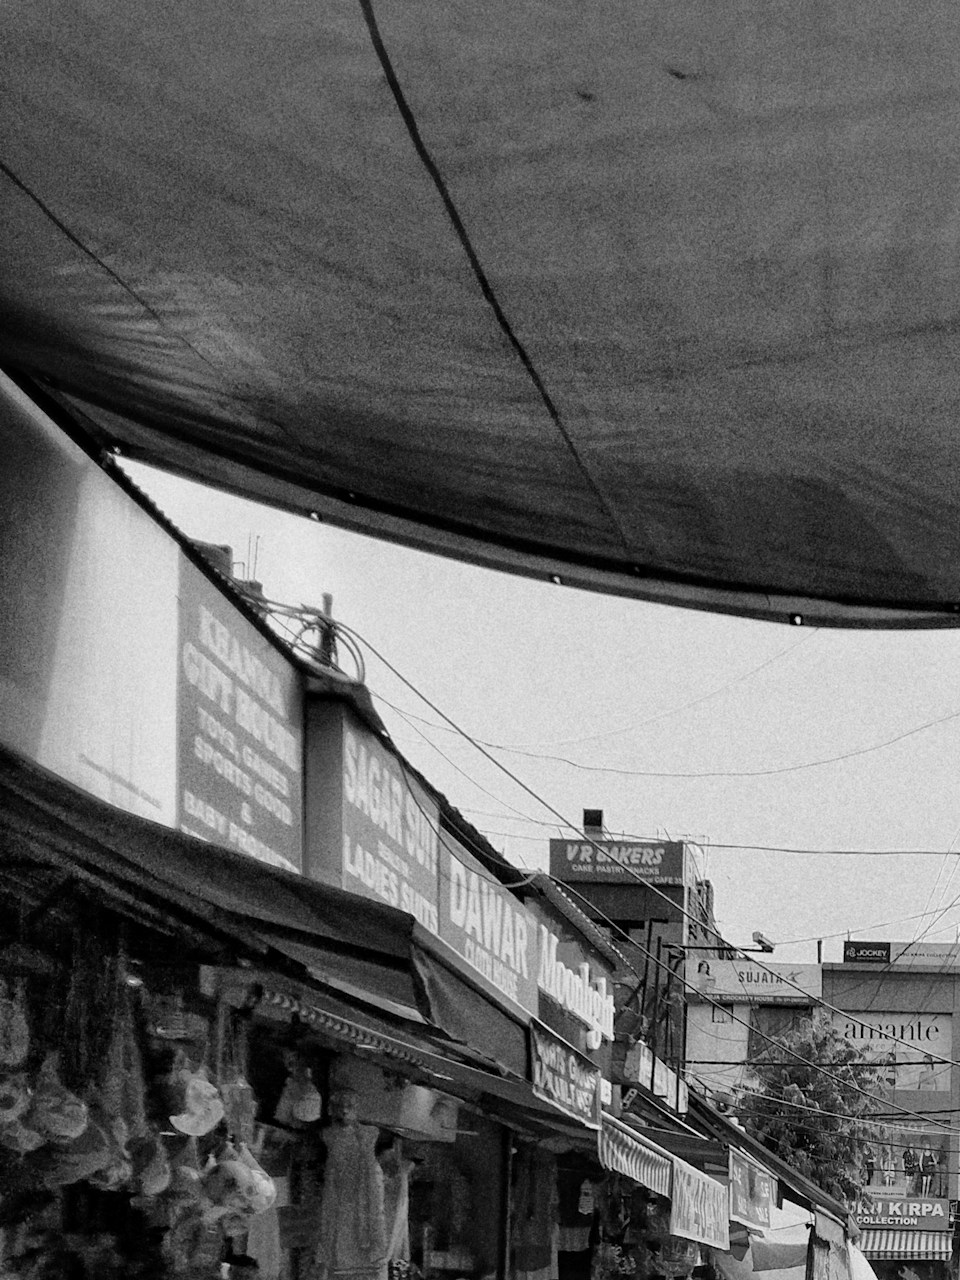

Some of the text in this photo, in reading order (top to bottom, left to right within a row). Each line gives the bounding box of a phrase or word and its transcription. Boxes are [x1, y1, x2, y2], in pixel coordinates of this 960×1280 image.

[182, 641, 233, 716] GIFT
[194, 735, 251, 797] SPORTS
[343, 731, 404, 846] SAGAR
[184, 789, 227, 835] BABY
[343, 832, 399, 908] LADIES
[596, 845, 666, 866] BAKERS
[596, 864, 626, 874] PASTRY
[450, 853, 529, 980] DAWAR
[856, 949, 888, 957] JOCKEY
[844, 1015, 941, 1041] amanté
[856, 1216, 918, 1225] COLLECTION
[888, 1202, 945, 1217] KIRPA
